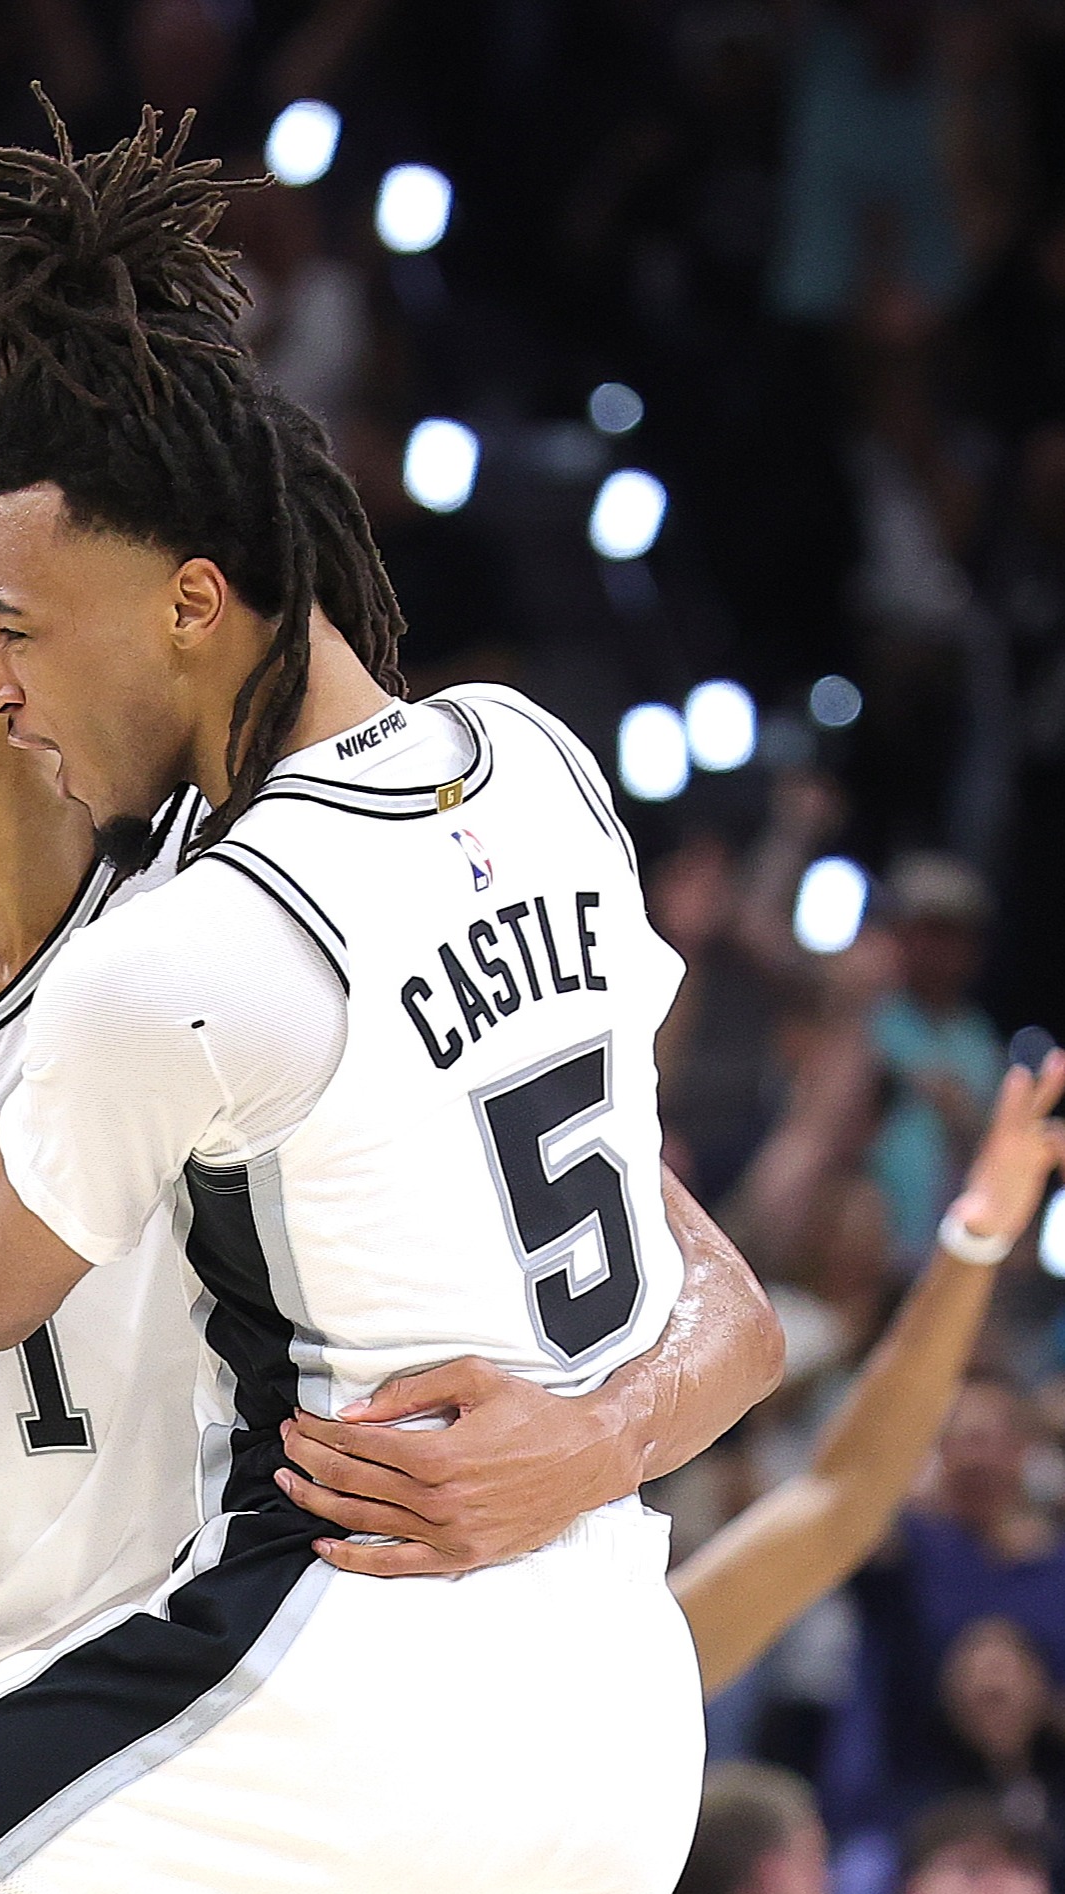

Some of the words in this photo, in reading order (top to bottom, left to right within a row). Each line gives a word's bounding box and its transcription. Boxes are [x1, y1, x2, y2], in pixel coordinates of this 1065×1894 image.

[336, 725, 382, 760] NIKE
[379, 710, 407, 739] PRO
[401, 892, 608, 1070] CASTLE
[468, 1030, 648, 1372] 5
[16, 1316, 97, 1457] 1
